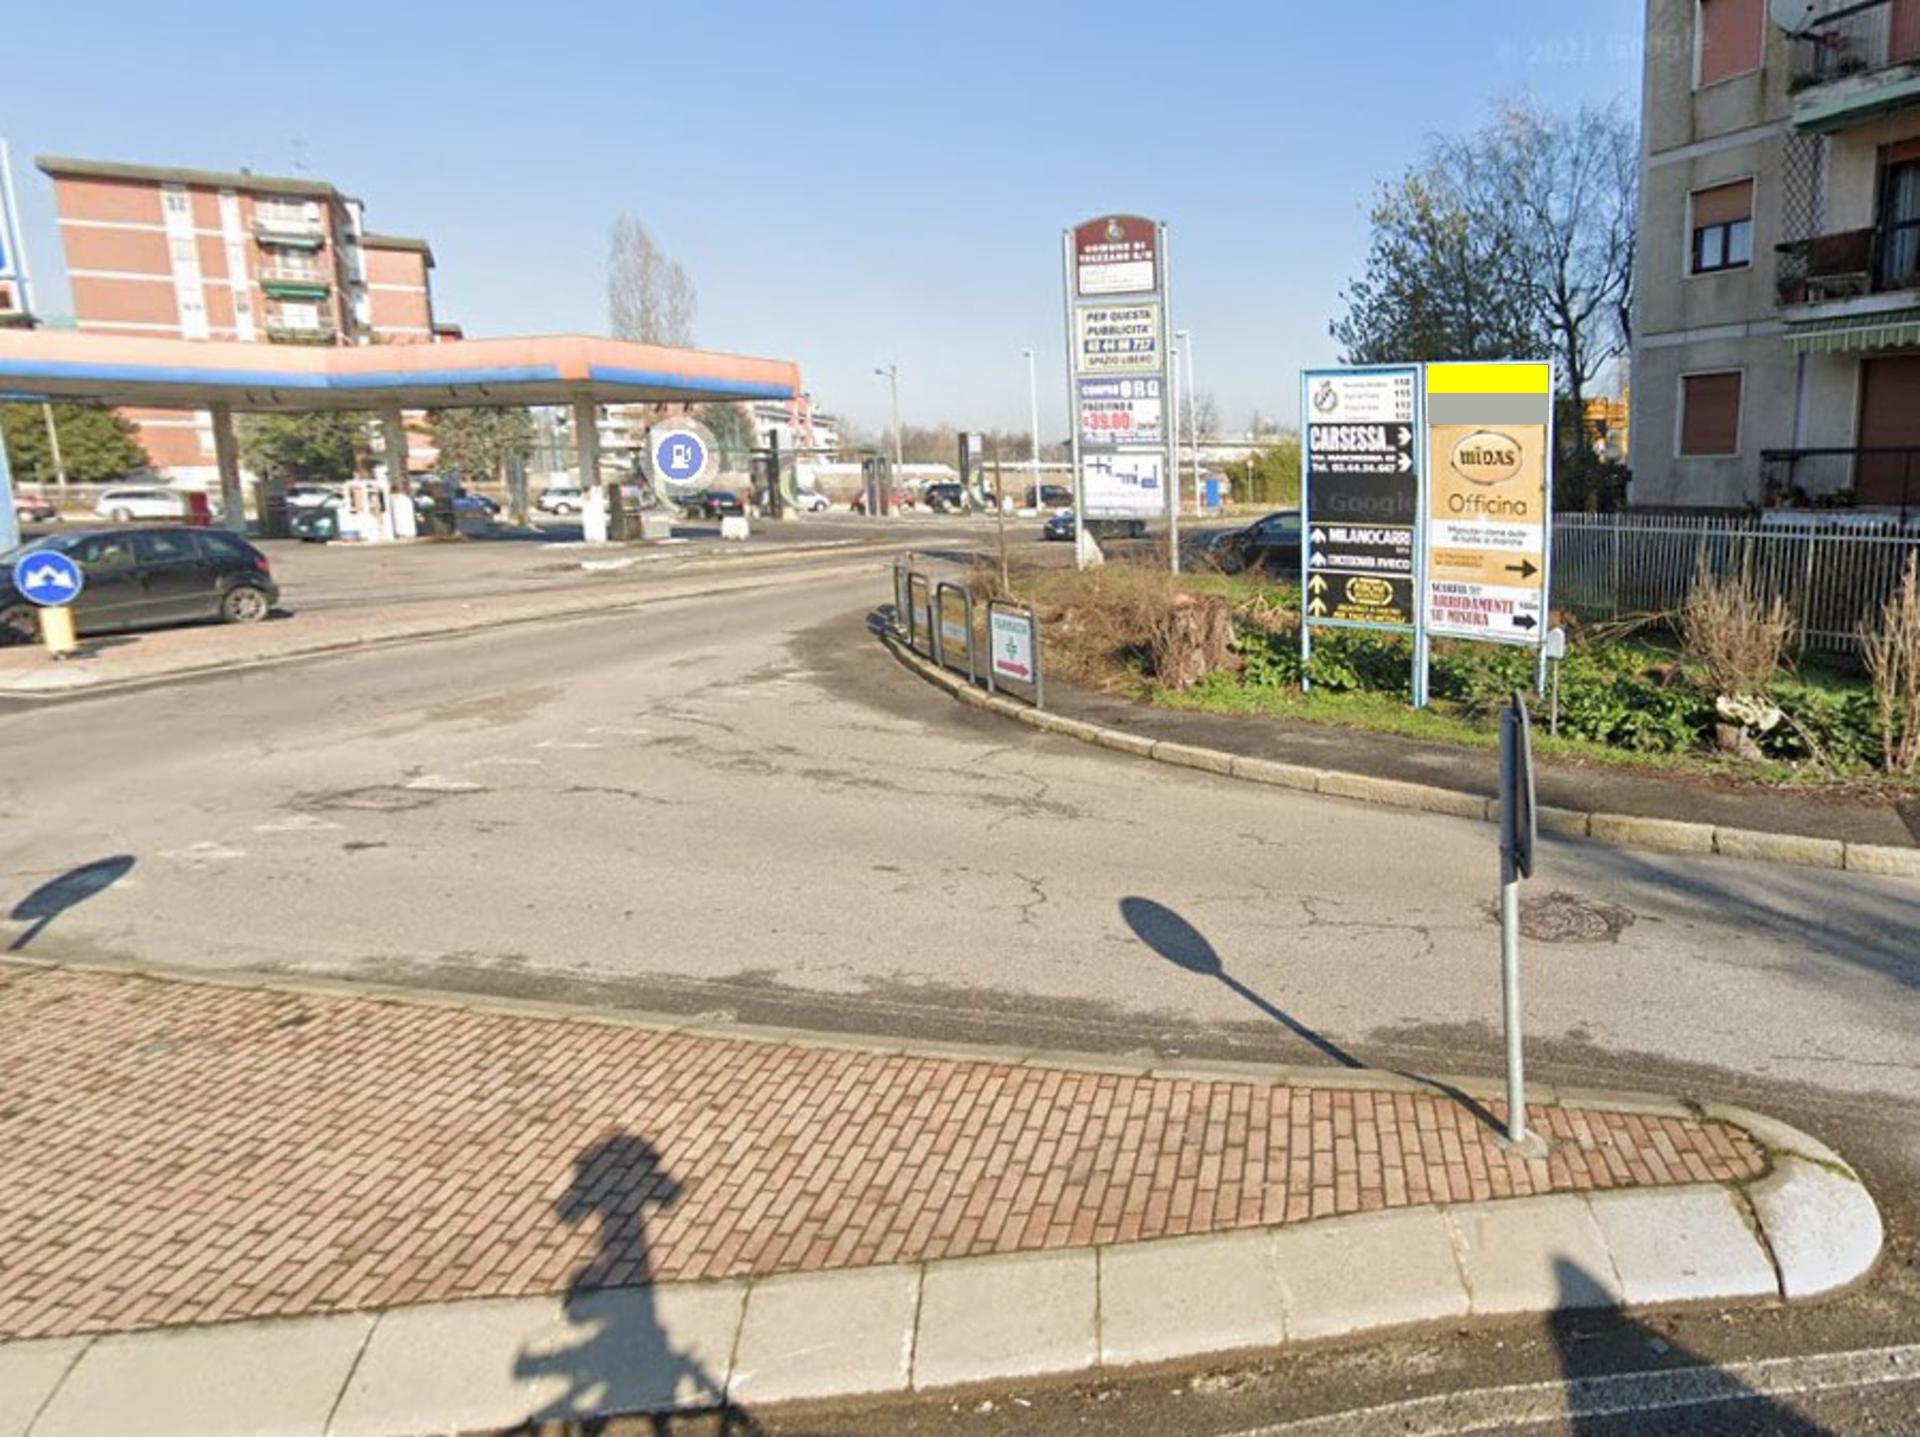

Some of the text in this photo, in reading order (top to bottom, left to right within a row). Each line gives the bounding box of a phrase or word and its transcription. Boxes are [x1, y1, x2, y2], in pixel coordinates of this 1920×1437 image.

[1086, 309, 1151, 322] PER QUESTA
[1088, 352, 1153, 366] SPAZIO LIBERO
[1310, 425, 1387, 452] CARSESSA
[1448, 493, 1527, 516] Officina
[1328, 528, 1411, 546] MILANOCARRI
[1377, 557, 1411, 569] IVECO
